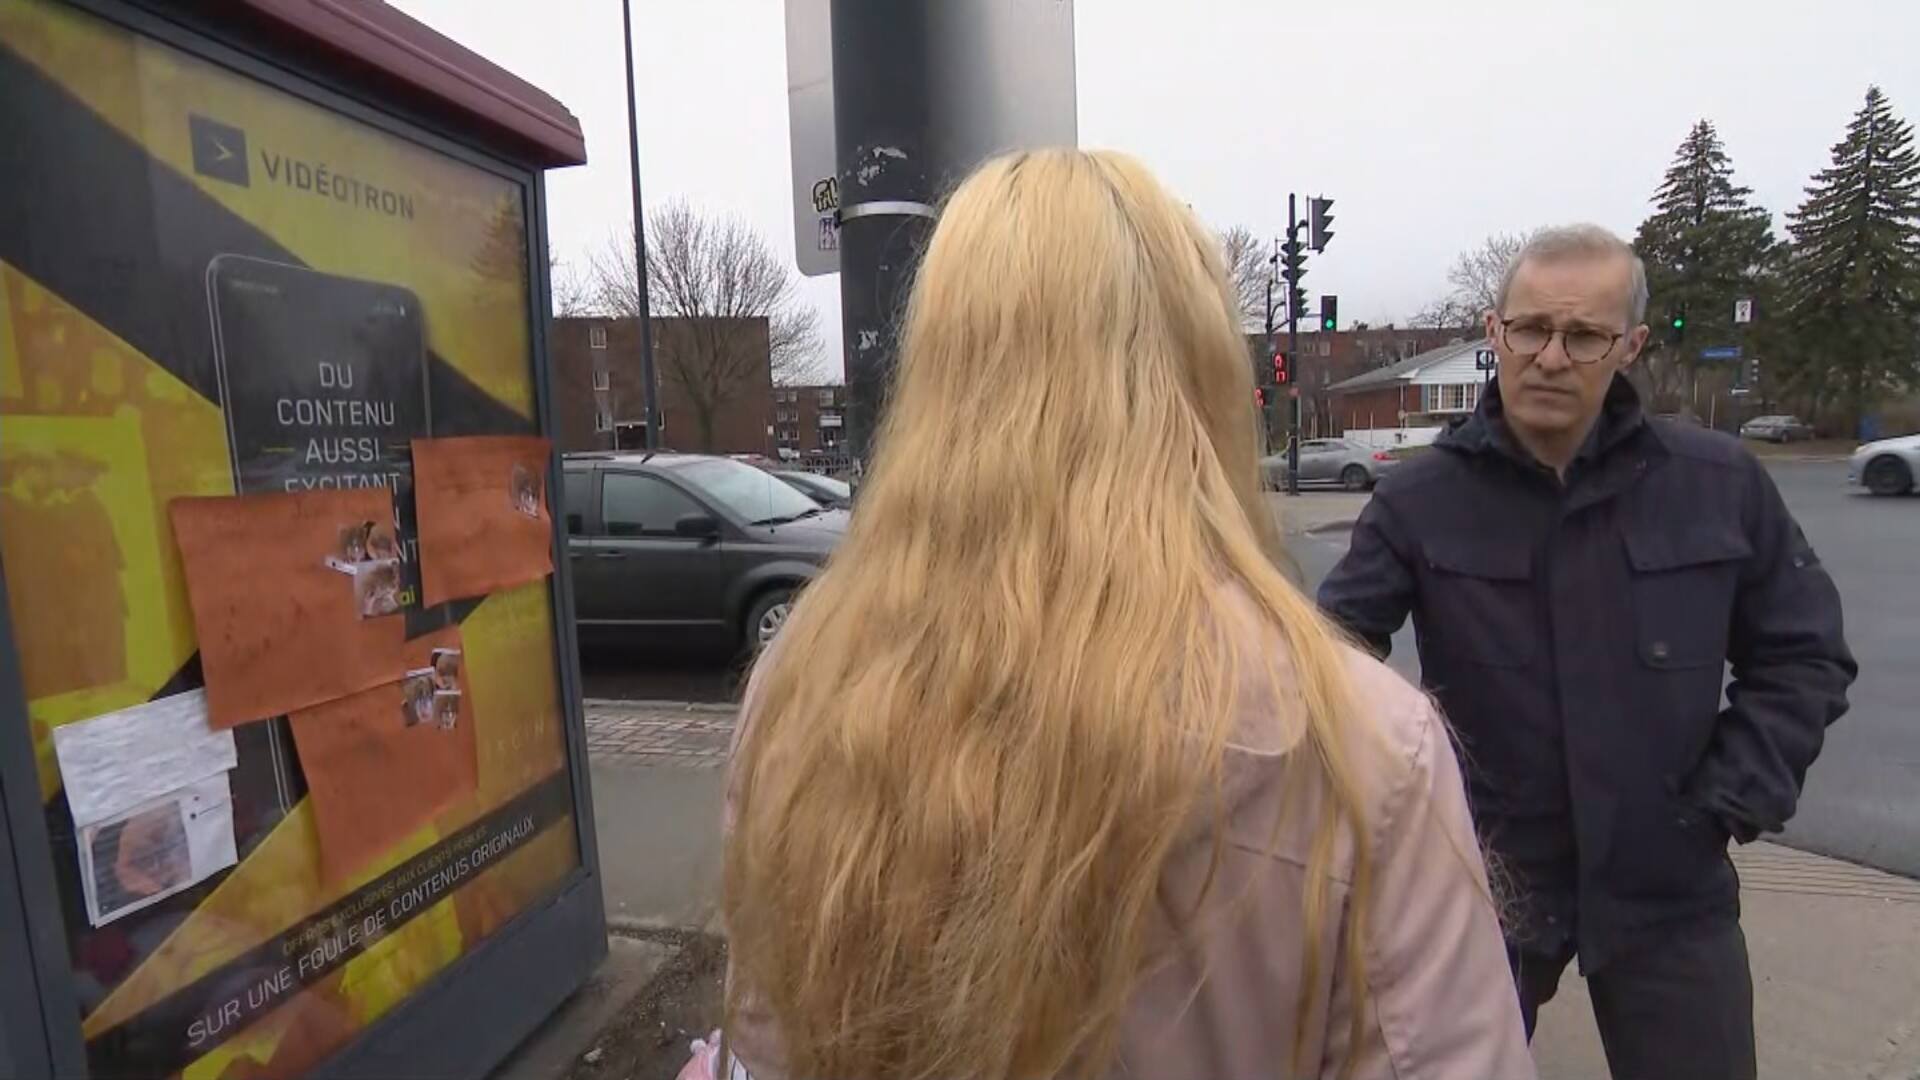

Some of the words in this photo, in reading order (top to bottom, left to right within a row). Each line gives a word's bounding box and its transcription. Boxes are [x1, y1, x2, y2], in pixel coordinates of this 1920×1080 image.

[260, 150, 415, 220] VIDÉOTRON
[319, 362, 353, 389] DU
[277, 399, 396, 426] CONTENU
[305, 437, 381, 465] AUSSI
[186, 999, 241, 1047] SUR
[247, 966, 292, 1009] UNE
[298, 924, 361, 979] FOULE
[363, 908, 386, 936] DE
[390, 857, 470, 920] CONTENUS
[471, 813, 535, 868] ORIGINAUX
